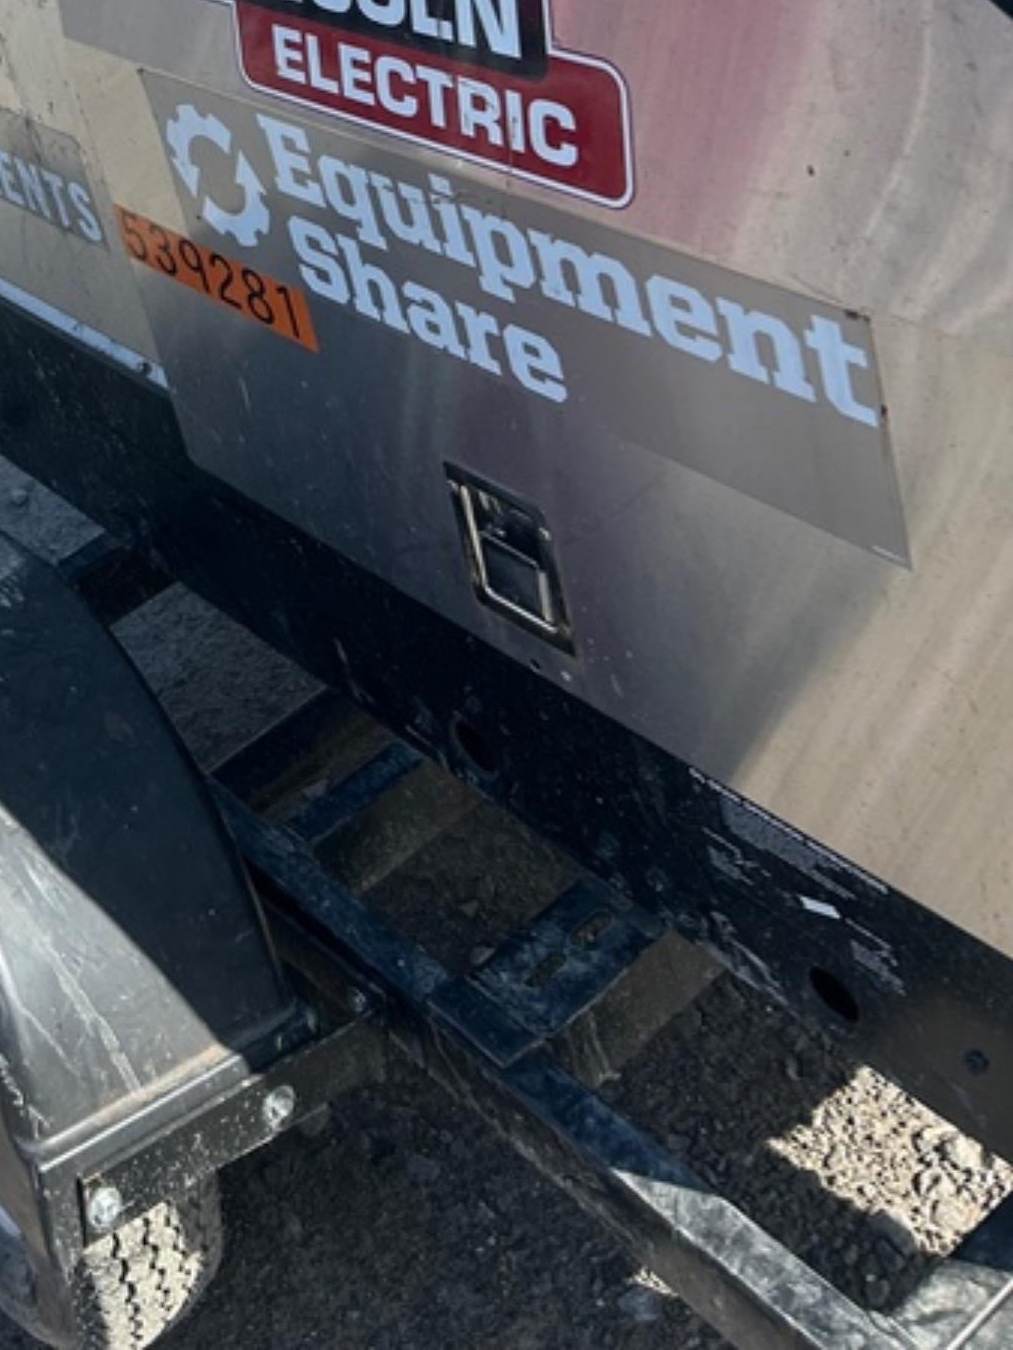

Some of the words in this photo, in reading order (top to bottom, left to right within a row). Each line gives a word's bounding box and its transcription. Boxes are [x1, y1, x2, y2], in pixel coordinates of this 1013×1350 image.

[271, 23, 578, 168] ELECTRIC
[121, 210, 301, 340] 539281
[255, 113, 879, 429] Equipment
[287, 218, 568, 404] Share
